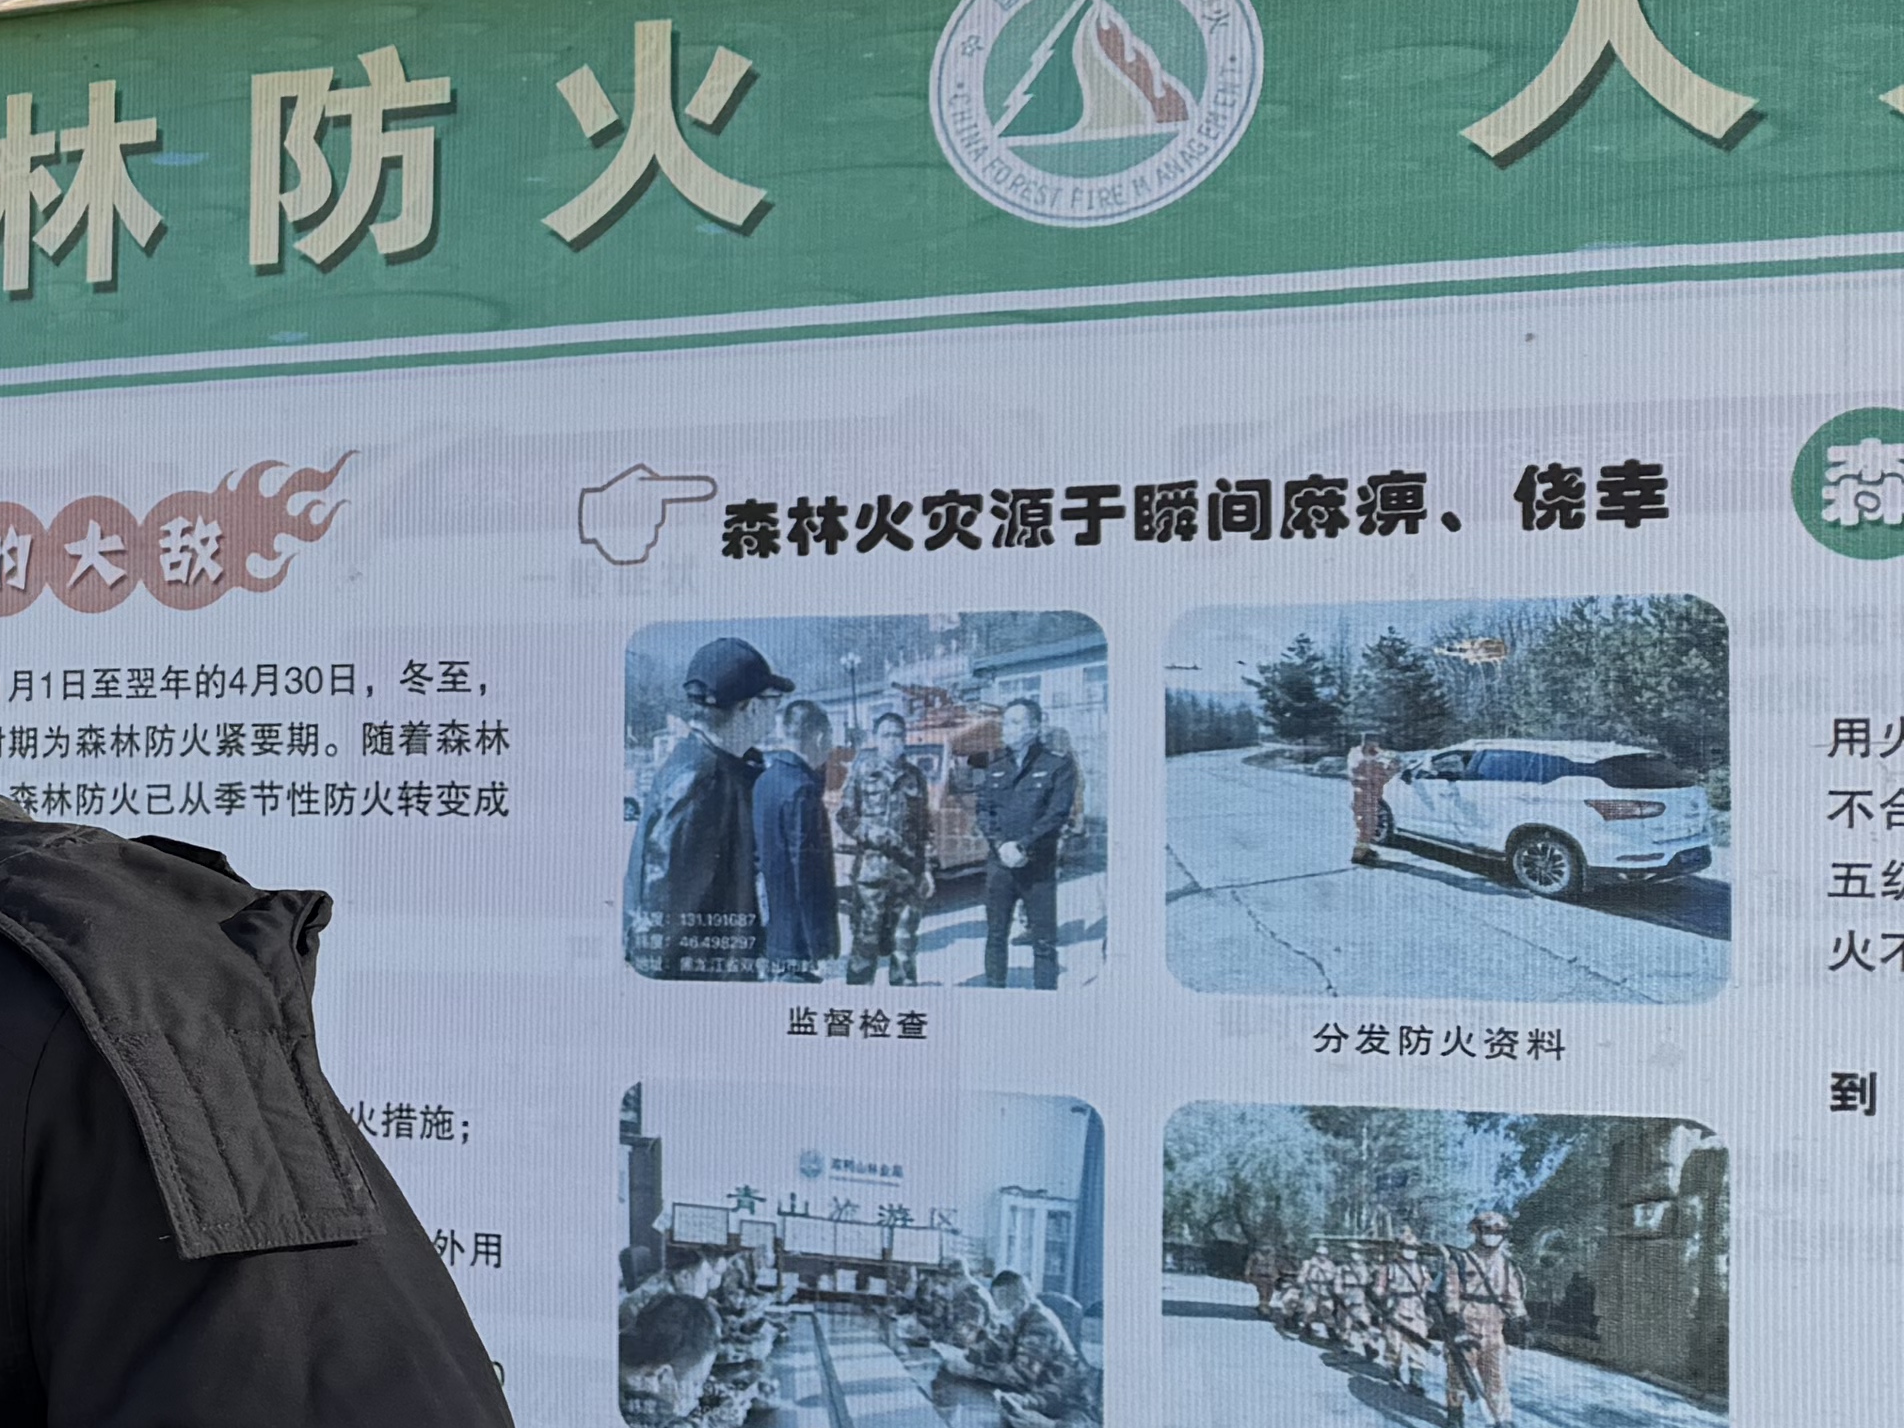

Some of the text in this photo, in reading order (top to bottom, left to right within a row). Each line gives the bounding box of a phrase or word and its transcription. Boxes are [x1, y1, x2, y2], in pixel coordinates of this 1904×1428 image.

[948, 91, 991, 163] CHINA
[982, 154, 1062, 209] FOREST
[1070, 184, 1128, 212] FIRE
[721, 459, 1669, 559] 森林火灾源于瞬间麻痹、侥幸
[787, 1006, 929, 1040] 监督检查
[1313, 1022, 1566, 1062] 分发防火资料
[1830, 1072, 1877, 1117] 到
